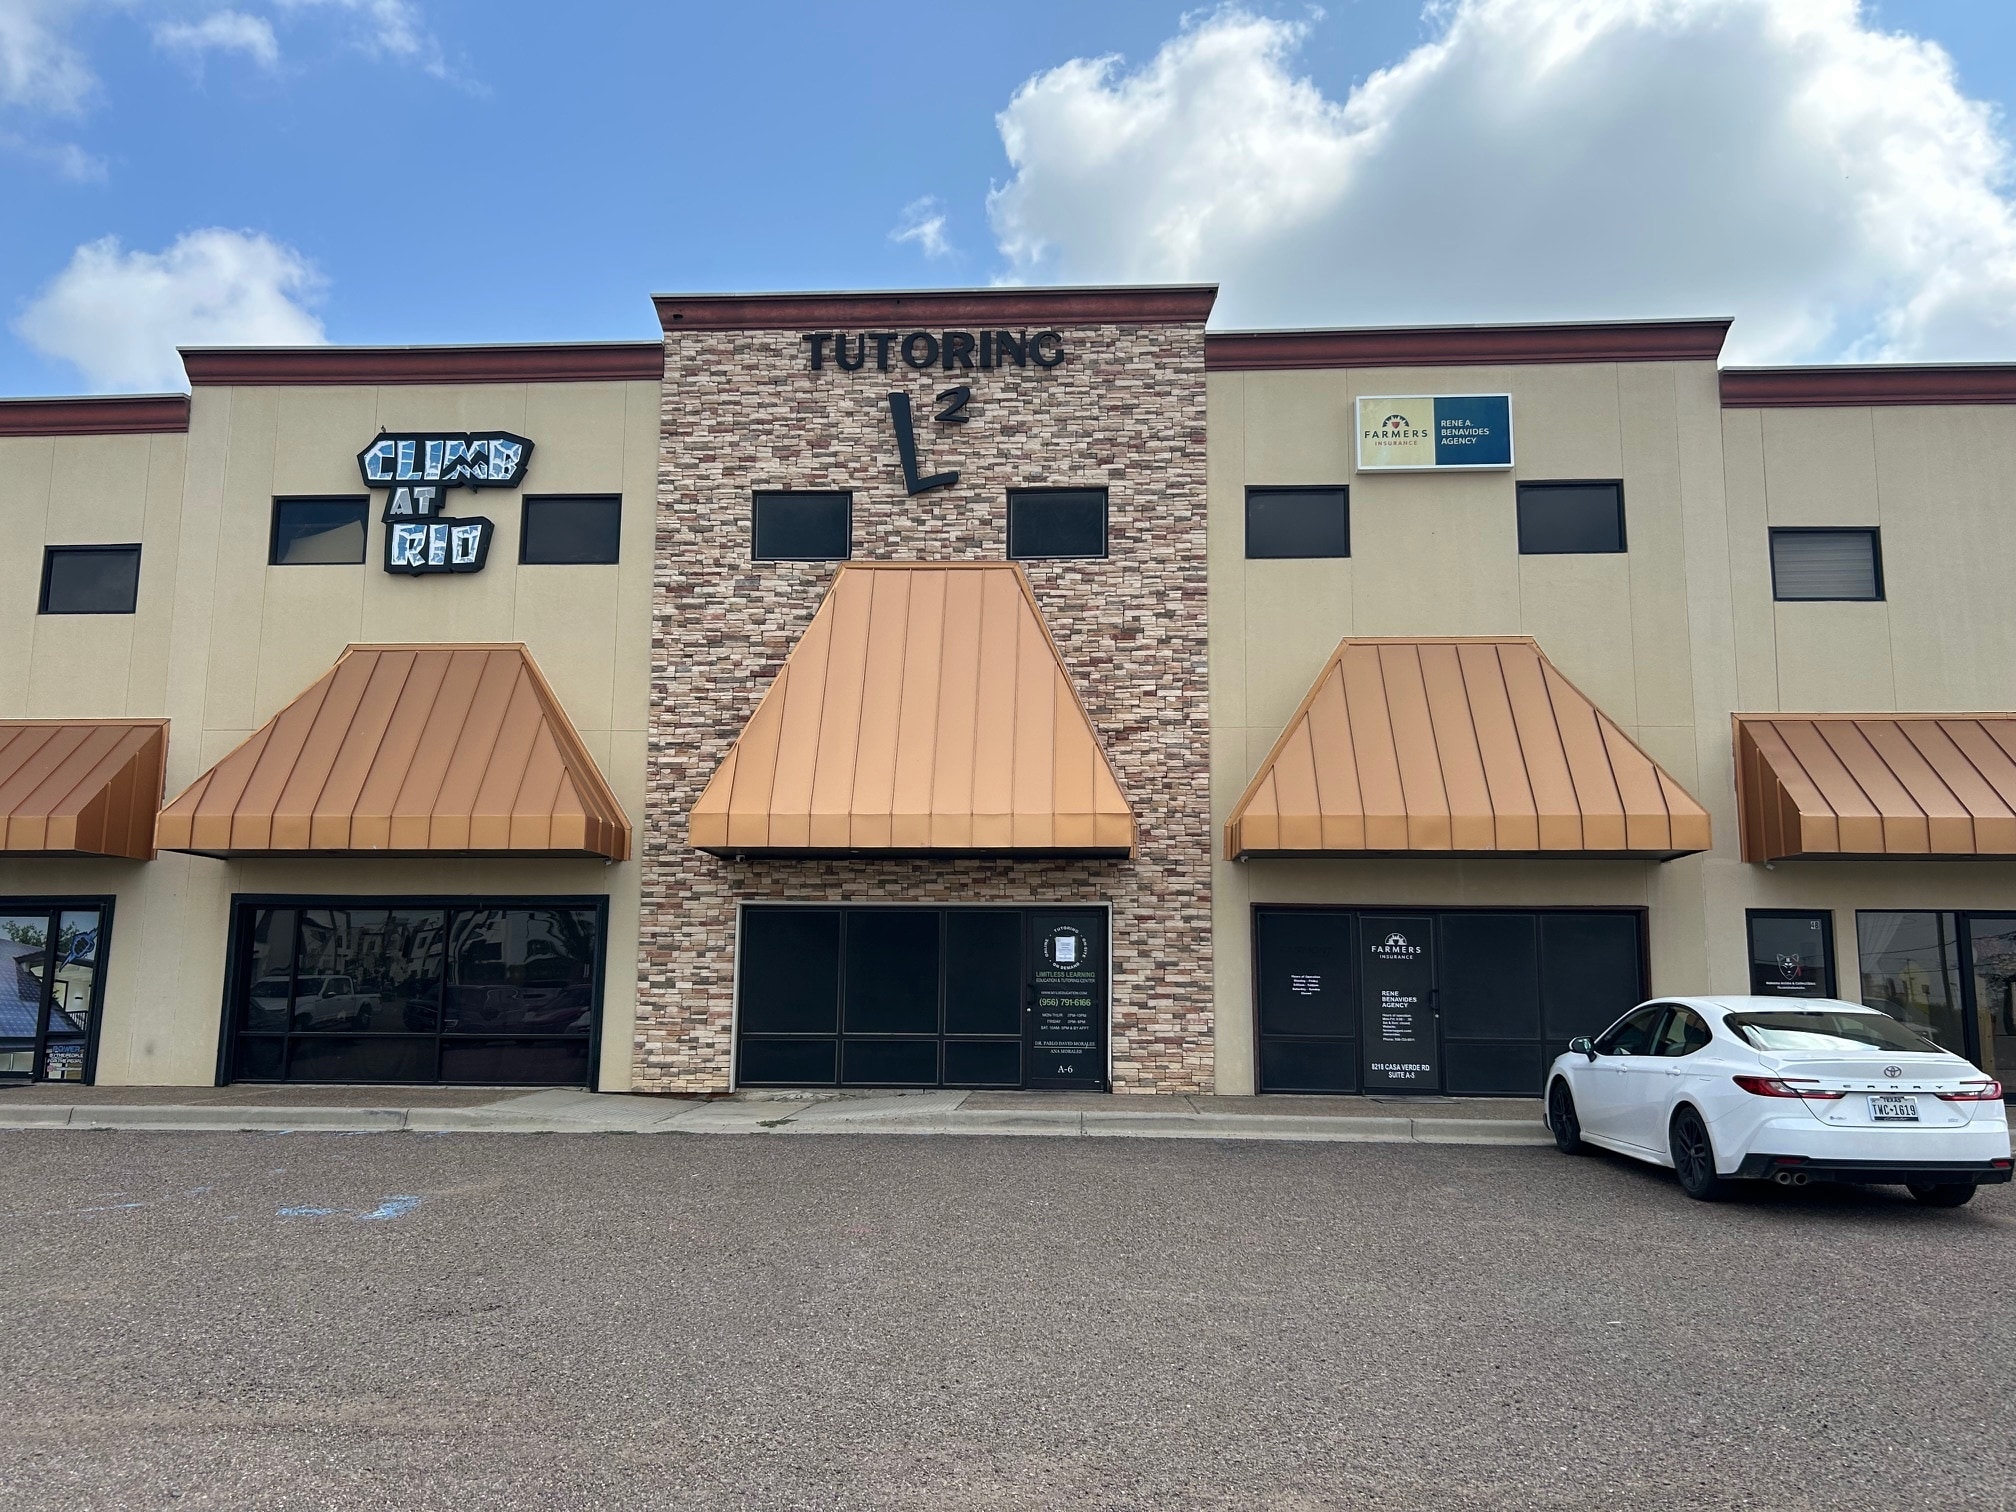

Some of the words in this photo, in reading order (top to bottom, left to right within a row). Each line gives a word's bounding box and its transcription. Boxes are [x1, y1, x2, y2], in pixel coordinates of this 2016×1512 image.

[802, 330, 1065, 371] TUTORING
[1440, 419, 1465, 427] RENE
[1465, 418, 1475, 426] A.
[1364, 429, 1429, 439] FARMERS
[1440, 428, 1490, 436] BENAVIDES
[1440, 437, 1478, 445] AGENCY
[364, 438, 524, 481] CLIMB
[389, 485, 437, 516] AT
[390, 523, 483, 567] RIO
[1371, 945, 1421, 954] FARMERS
[1039, 998, 1059, 1007] (956)
[1060, 998, 1092, 1007] 791-6166
[1057, 1065, 1074, 1074] A-6
[1384, 1063, 1401, 1071] CASA
[1421, 1064, 1430, 1072] RD
[1388, 1071, 1405, 1079] SUITE
